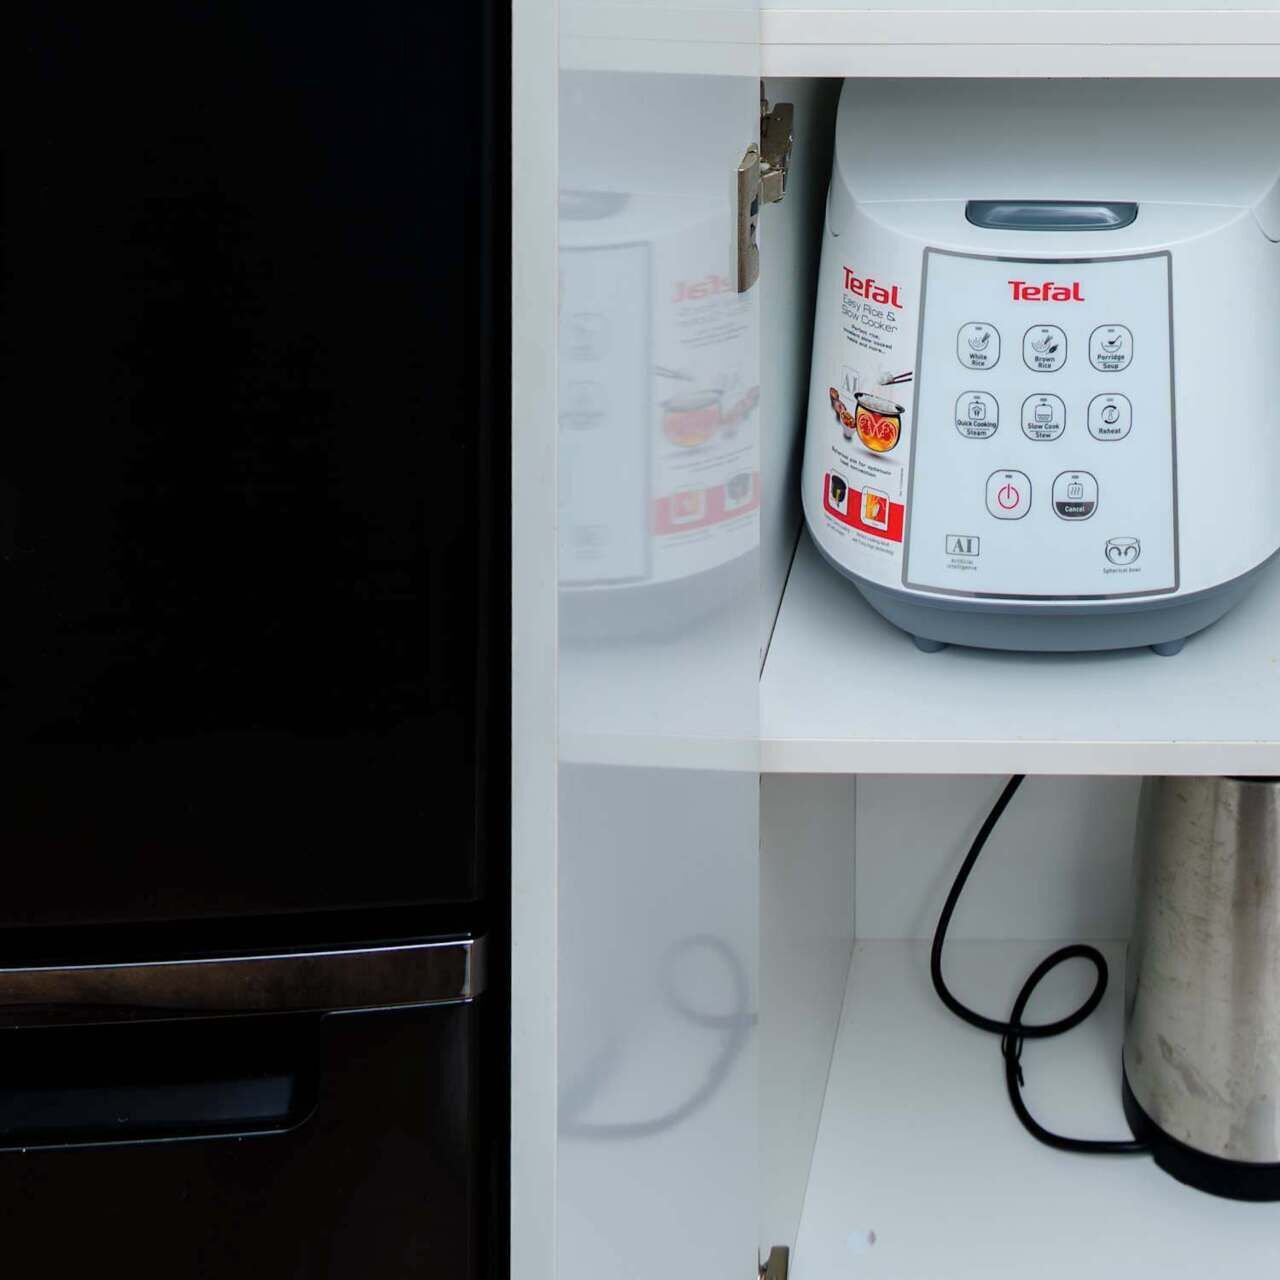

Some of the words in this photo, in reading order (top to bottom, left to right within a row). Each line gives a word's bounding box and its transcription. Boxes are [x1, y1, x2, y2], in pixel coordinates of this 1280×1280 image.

[843, 266, 903, 309] Tefal
[1008, 280, 1086, 302] Tefal
[842, 293, 861, 311] Easy
[863, 303, 884, 319] Rice
[887, 311, 896, 321] &
[841, 303, 860, 321] Slow
[861, 315, 898, 333] Cooker
[969, 353, 987, 361] White
[1034, 355, 1055, 363] Brown
[1097, 354, 1125, 362] Porridge
[972, 359, 985, 367] Rice
[1038, 362, 1052, 370] Rice
[957, 420, 972, 428] Quick
[973, 420, 997, 429] Cooking
[1099, 427, 1121, 435] Reheat
[1064, 505, 1085, 513] Cancel
[952, 538, 973, 553] AI
